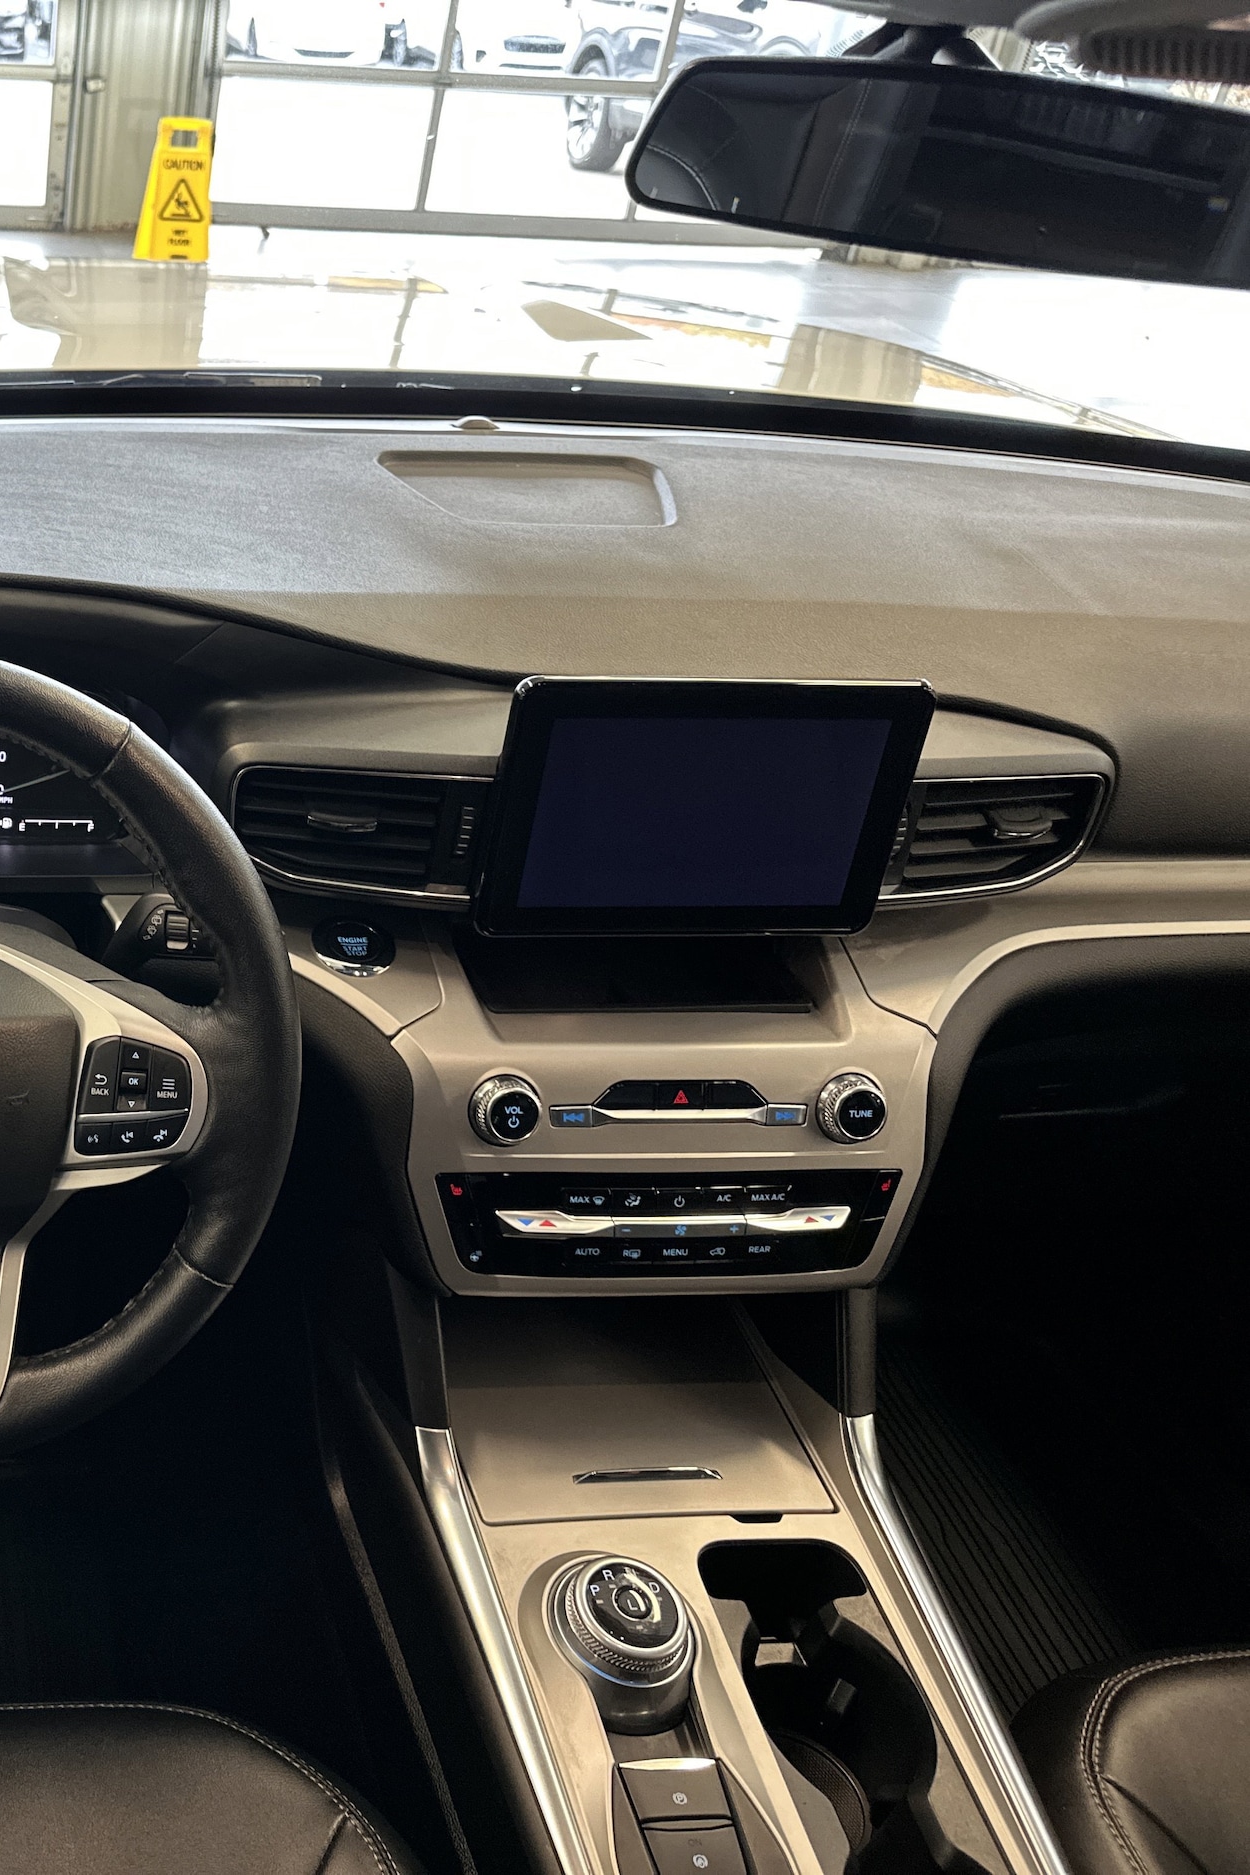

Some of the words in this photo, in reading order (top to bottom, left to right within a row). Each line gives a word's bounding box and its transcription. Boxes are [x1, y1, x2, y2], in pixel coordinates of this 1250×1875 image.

[163, 158, 205, 171] CAUTION
[18, 822, 26, 832] E
[337, 936, 368, 944] ENGINE
[128, 1077, 139, 1086] OK
[90, 1088, 110, 1096] BACK
[156, 1090, 178, 1099] MENU
[504, 1105, 524, 1115] VOL
[848, 1109, 874, 1118] TUNE
[569, 1195, 590, 1204] MAX
[716, 1194, 732, 1202] A/C
[751, 1193, 770, 1202] MAX
[770, 1193, 786, 1201] A/C
[574, 1247, 601, 1256] AUTO
[662, 1248, 689, 1257] MENU
[748, 1245, 771, 1254] REAR
[602, 1569, 616, 1581] R
[589, 1584, 600, 1597] P
[648, 1581, 661, 1594] D
[627, 1599, 639, 1611] L
